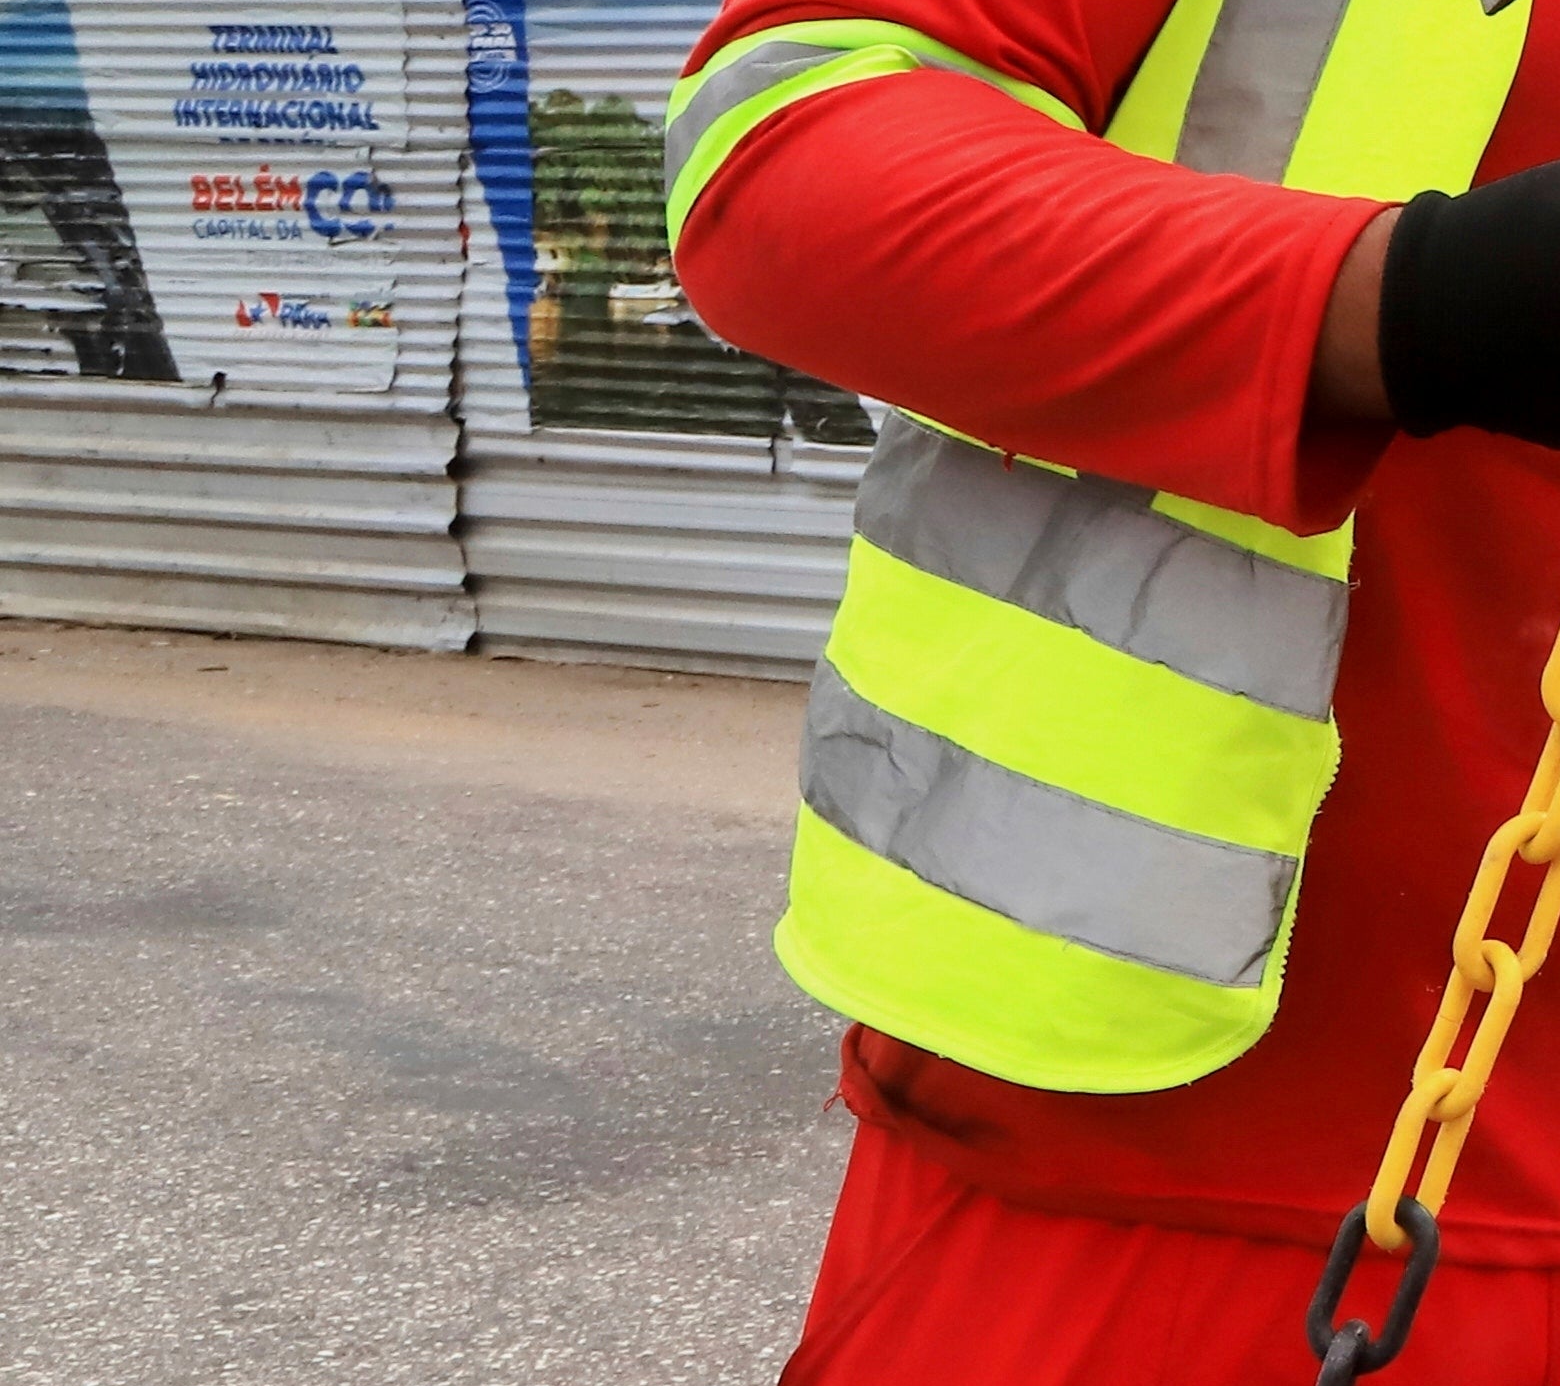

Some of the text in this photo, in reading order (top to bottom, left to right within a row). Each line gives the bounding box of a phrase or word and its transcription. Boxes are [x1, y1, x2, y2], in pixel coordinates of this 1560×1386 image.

[208, 25, 338, 53] TERMINAL
[174, 100, 379, 130] INTERNACIONAL
[190, 164, 303, 211] BELÉM
[193, 218, 271, 240] CAPITAL
